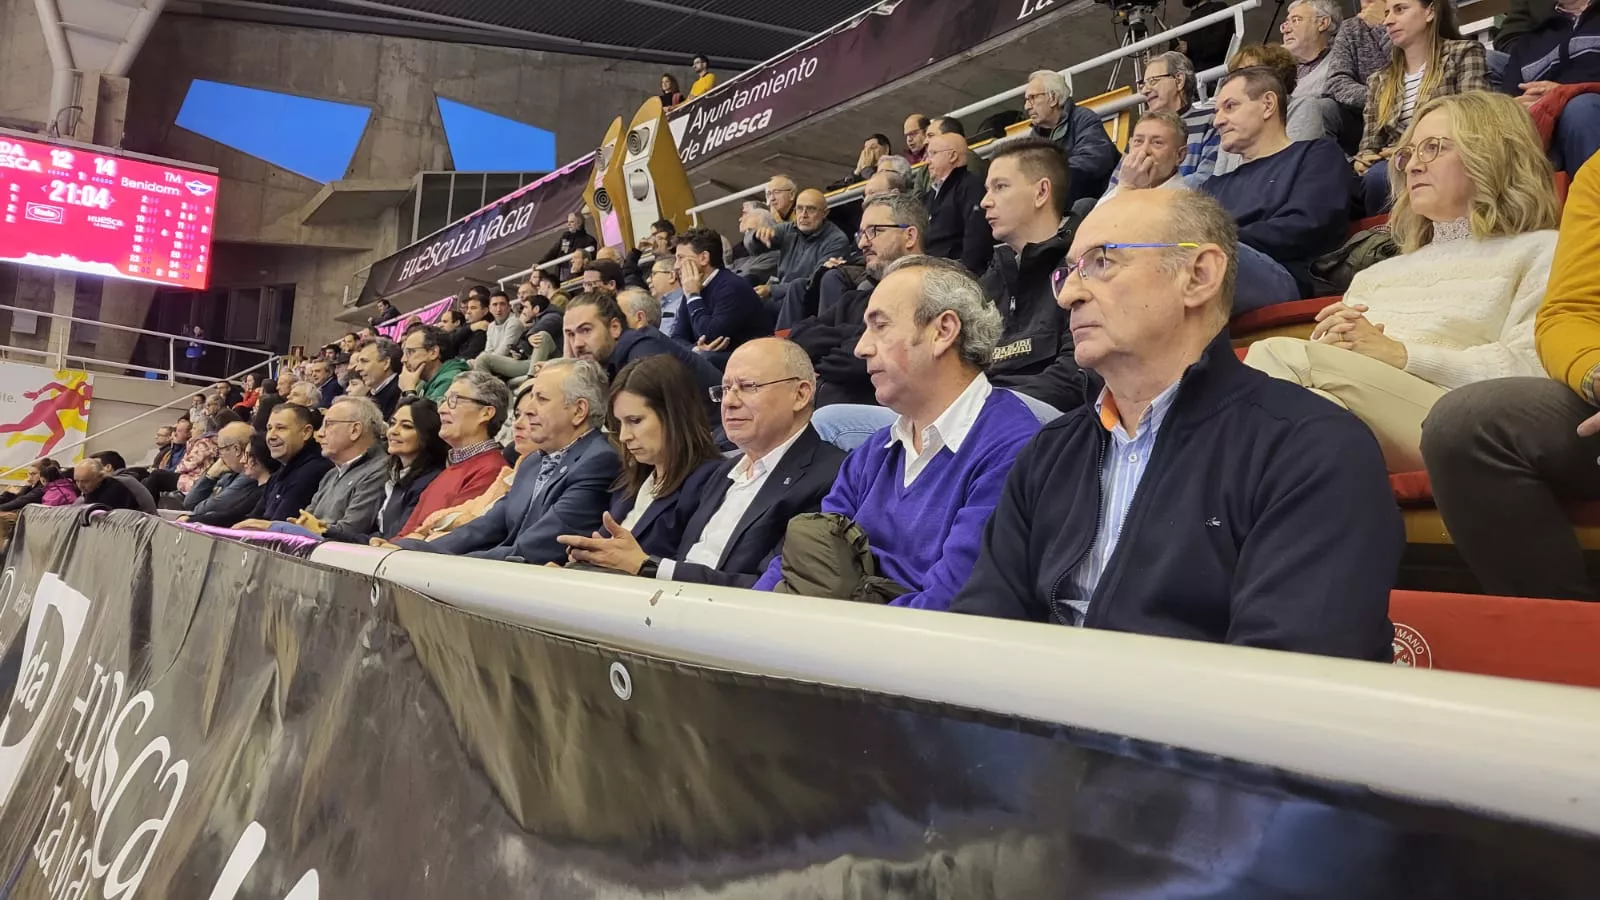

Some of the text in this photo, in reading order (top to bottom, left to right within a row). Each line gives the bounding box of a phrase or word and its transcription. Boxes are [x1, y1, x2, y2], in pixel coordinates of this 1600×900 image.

[689, 56, 818, 135] Ayuntamiento
[680, 108, 773, 164] de Huesca
[50, 149, 75, 169] 12
[94, 157, 117, 177] 14
[121, 176, 180, 196] Benidorm
[164, 171, 182, 184] TM
[49, 179, 110, 210] 21:04
[1394, 627, 1425, 655] MANO
